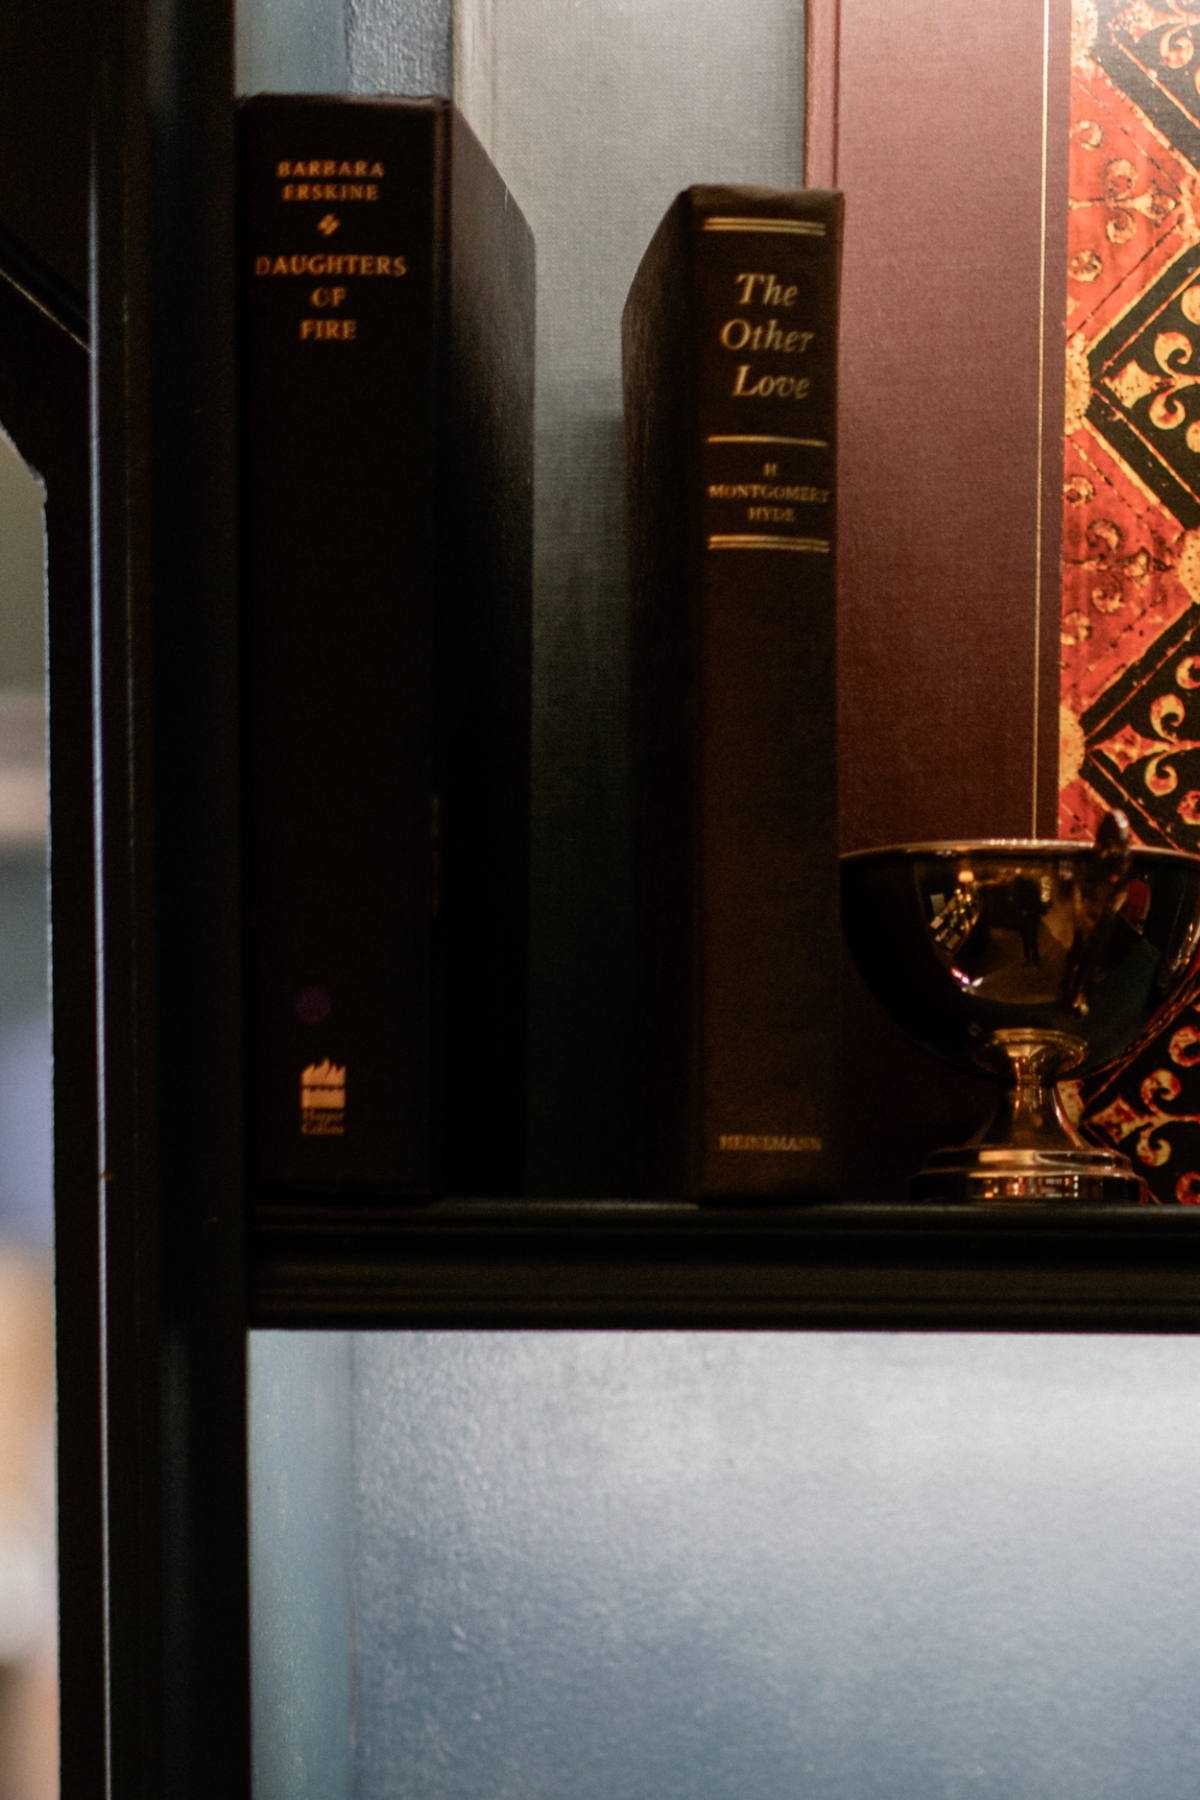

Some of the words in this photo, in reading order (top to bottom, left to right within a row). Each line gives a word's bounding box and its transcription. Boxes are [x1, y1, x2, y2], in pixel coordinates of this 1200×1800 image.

[277, 159, 384, 179] BARBARA
[282, 184, 378, 201] ERSKINE
[255, 254, 408, 278] DAUGHTERS
[310, 286, 347, 307] OF
[736, 273, 799, 307] The
[299, 319, 357, 341] FIRE
[720, 319, 815, 353] Other
[732, 365, 811, 400] Love
[747, 506, 796, 522] HYDE
